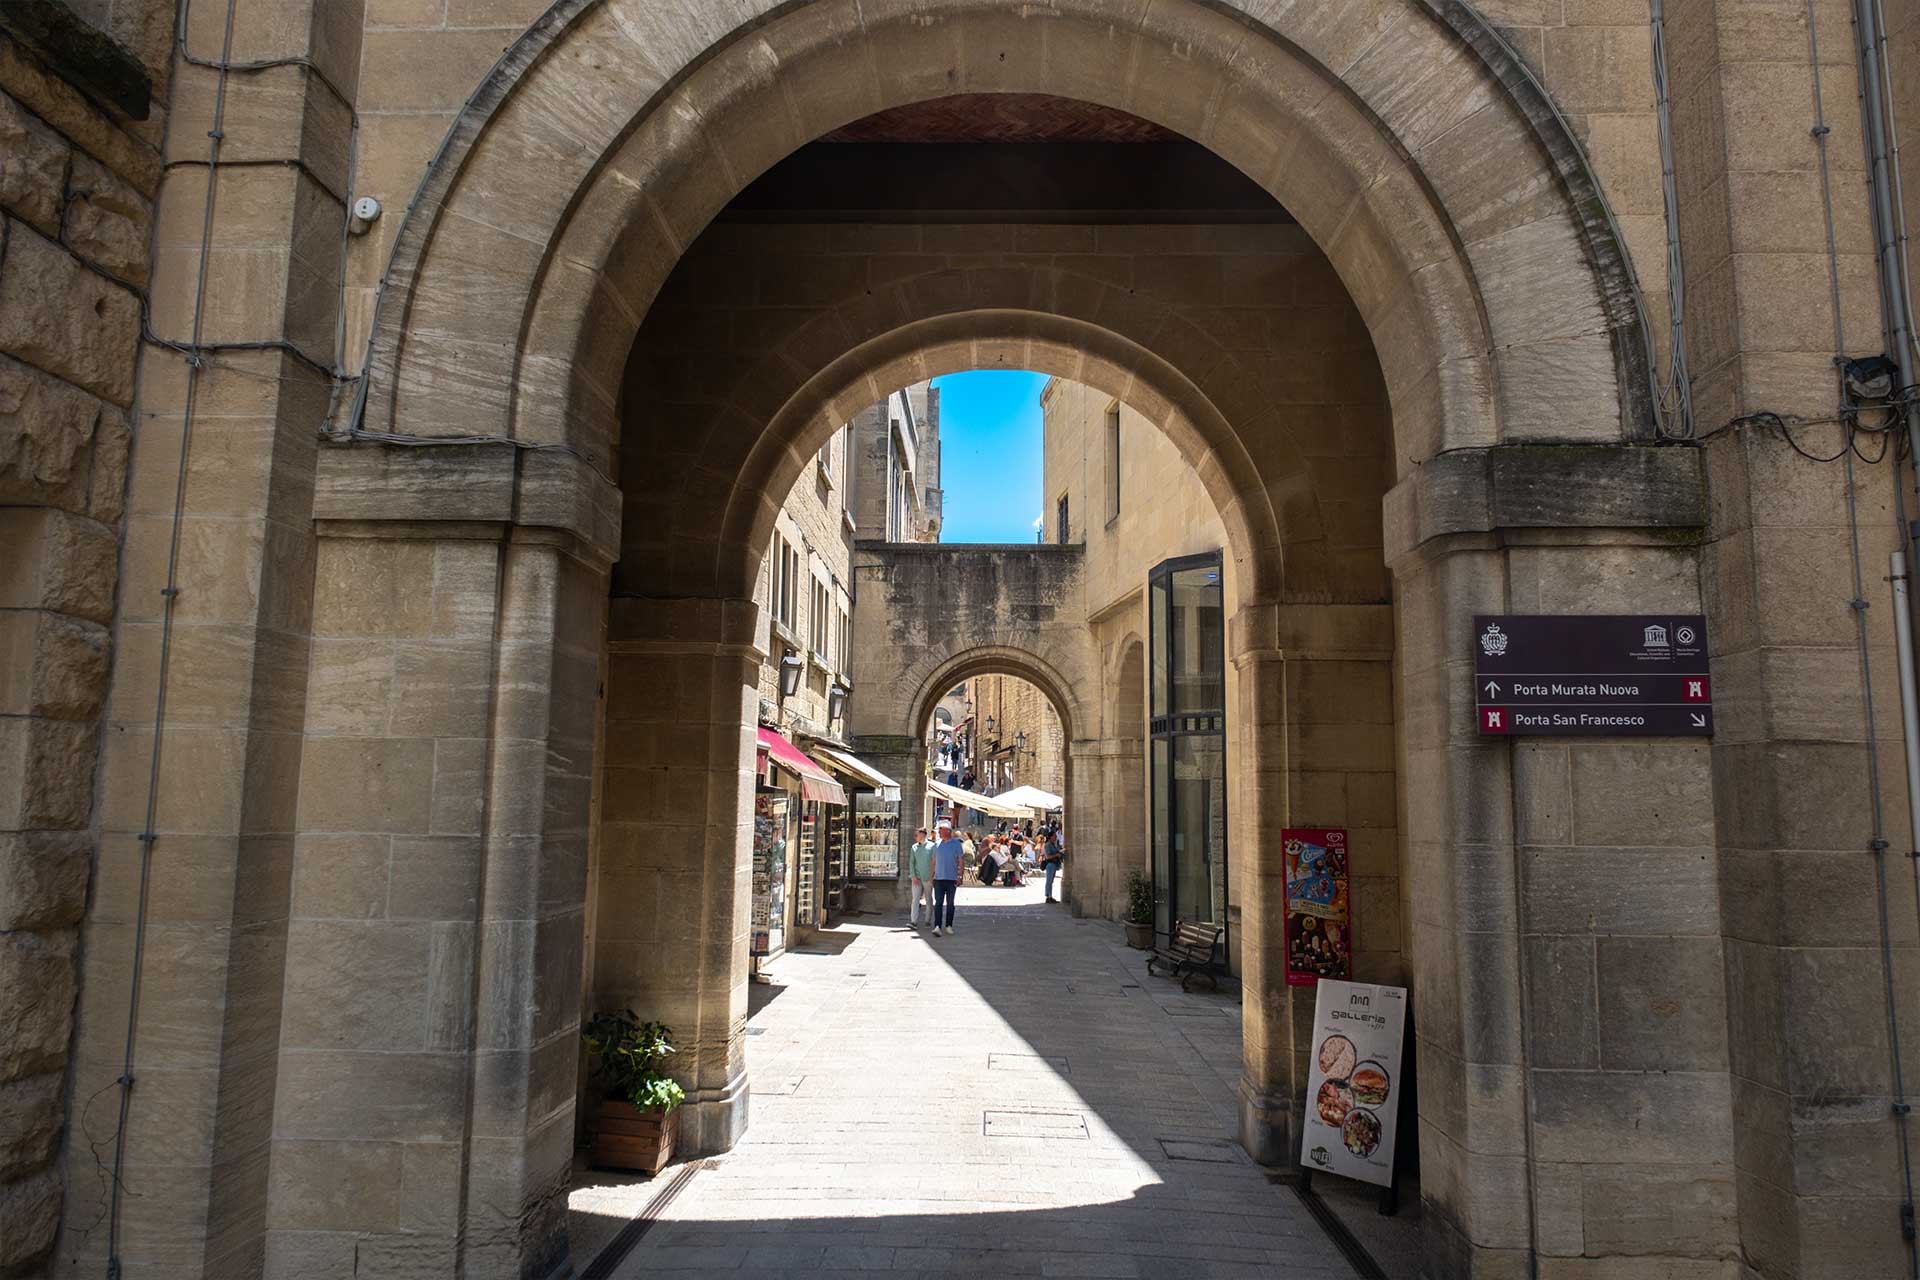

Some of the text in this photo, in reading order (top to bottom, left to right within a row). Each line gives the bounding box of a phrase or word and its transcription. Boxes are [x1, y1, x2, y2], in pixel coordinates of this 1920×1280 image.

[1514, 684, 1639, 696] Porta Murata Nuova
[1516, 714, 1645, 726] Porta San Francesco
[1332, 1010, 1386, 1023] galleria
